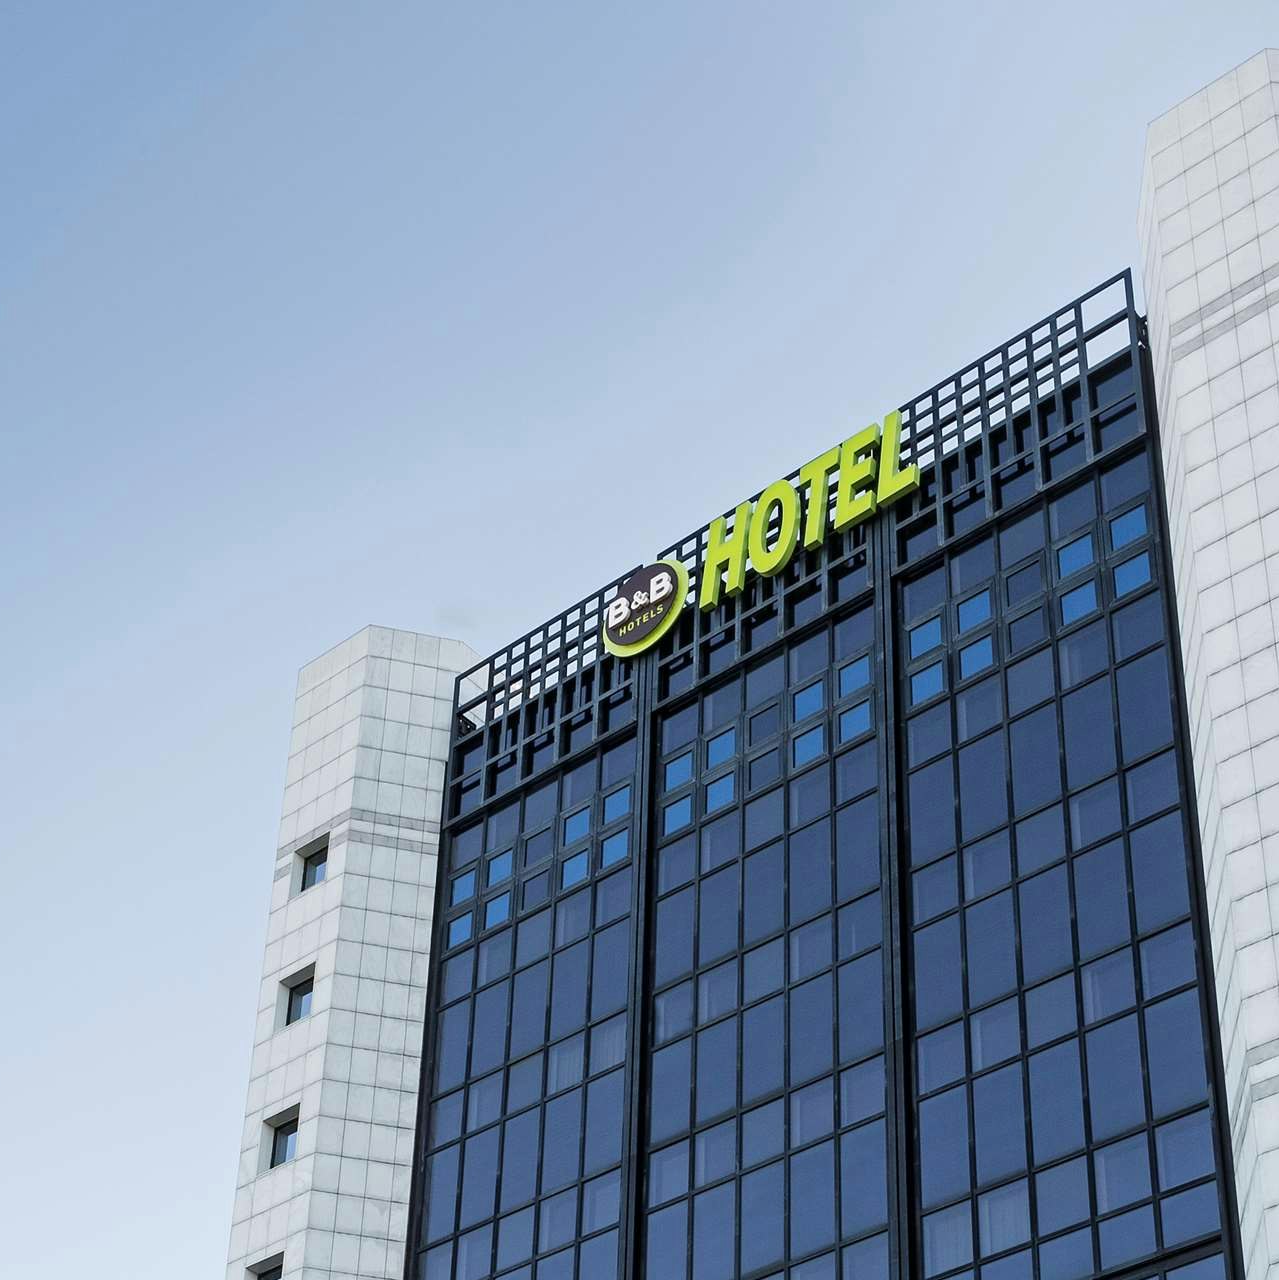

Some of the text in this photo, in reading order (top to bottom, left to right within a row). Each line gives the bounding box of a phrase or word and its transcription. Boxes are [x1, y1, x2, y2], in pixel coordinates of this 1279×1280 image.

[699, 409, 920, 612] HOTEL
[608, 572, 674, 629] B&B
[619, 604, 664, 637] HOTELS
